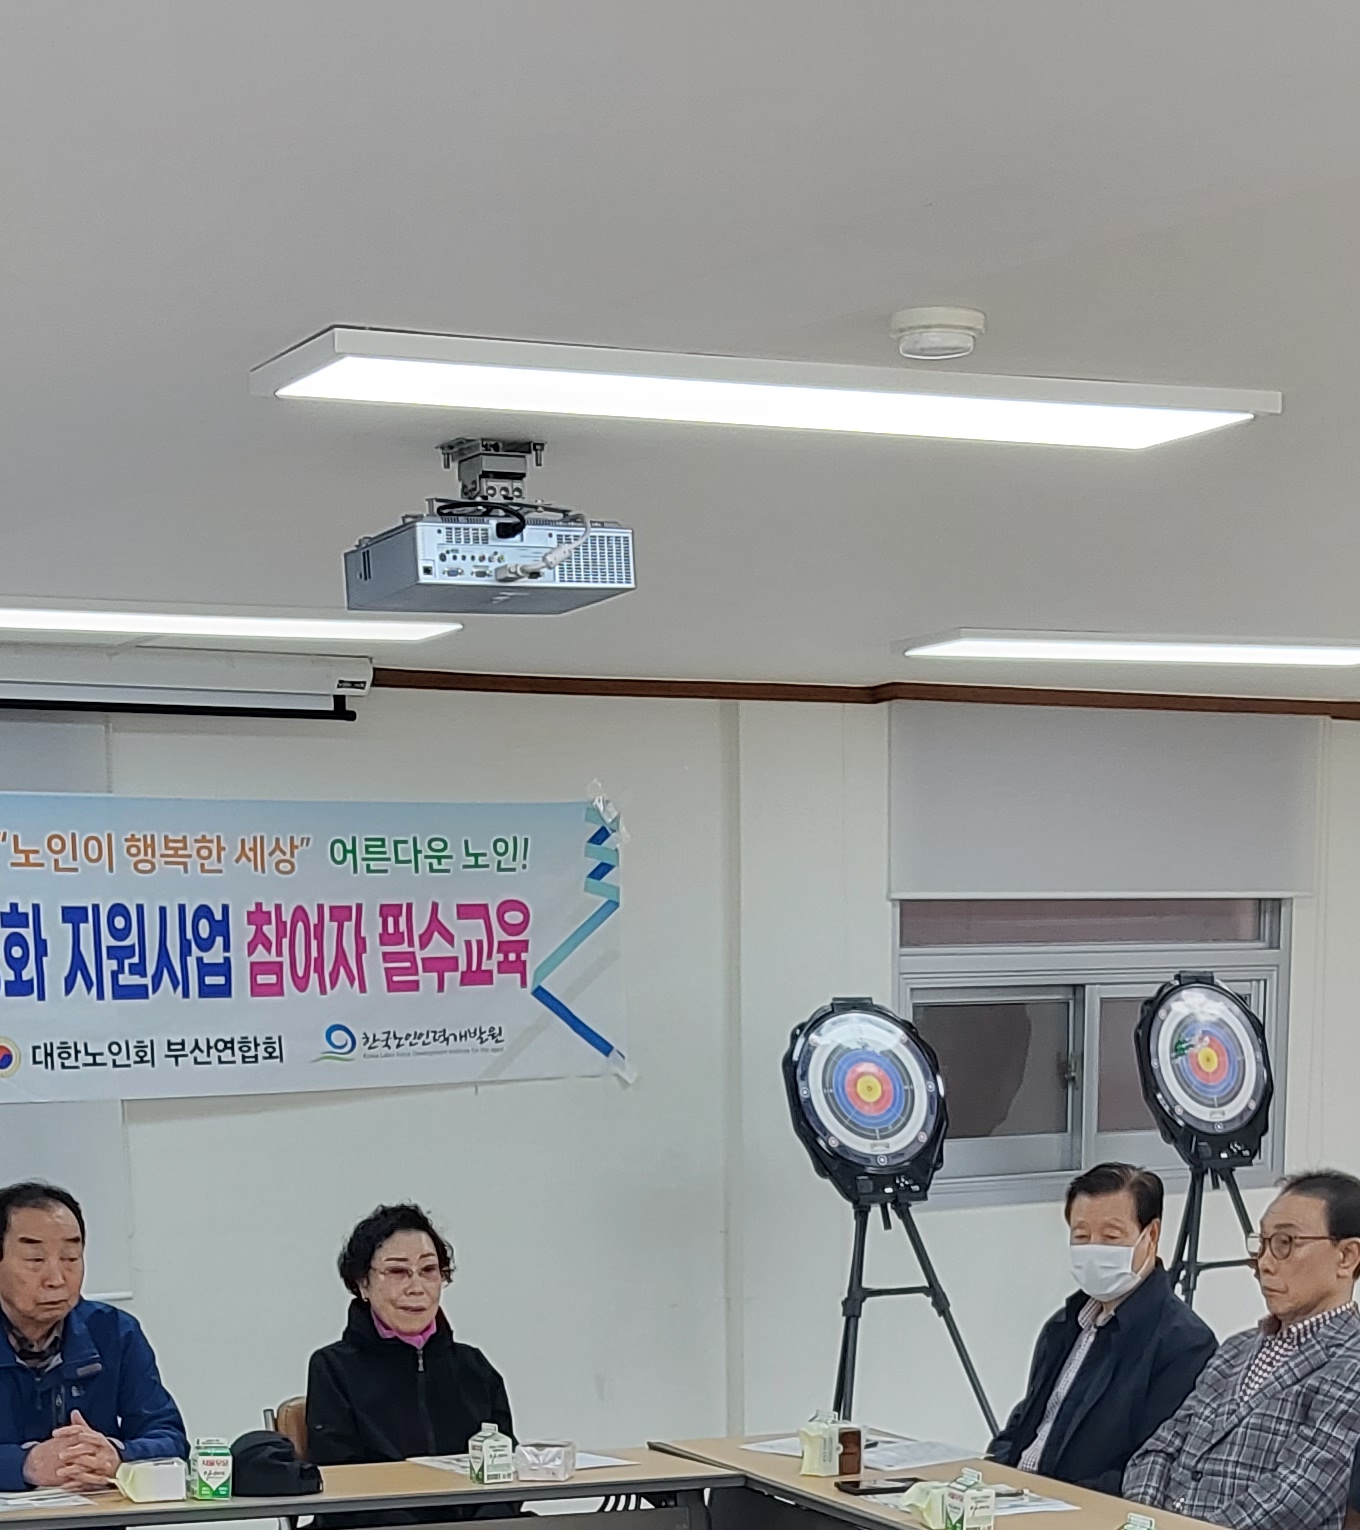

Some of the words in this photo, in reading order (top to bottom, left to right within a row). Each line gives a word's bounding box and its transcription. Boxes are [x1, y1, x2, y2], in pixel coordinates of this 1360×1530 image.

[124, 832, 226, 876] 행복한
[329, 836, 454, 876] 어른다운
[461, 836, 530, 874] 노인!
[60, 902, 233, 1001] 지원사업
[245, 900, 368, 998] 참여자
[378, 898, 532, 995] 필수교육
[31, 1038, 156, 1069] 대한노인회
[163, 1035, 285, 1067] 부산연합회
[361, 1025, 505, 1050] 한국노인인력개발원
